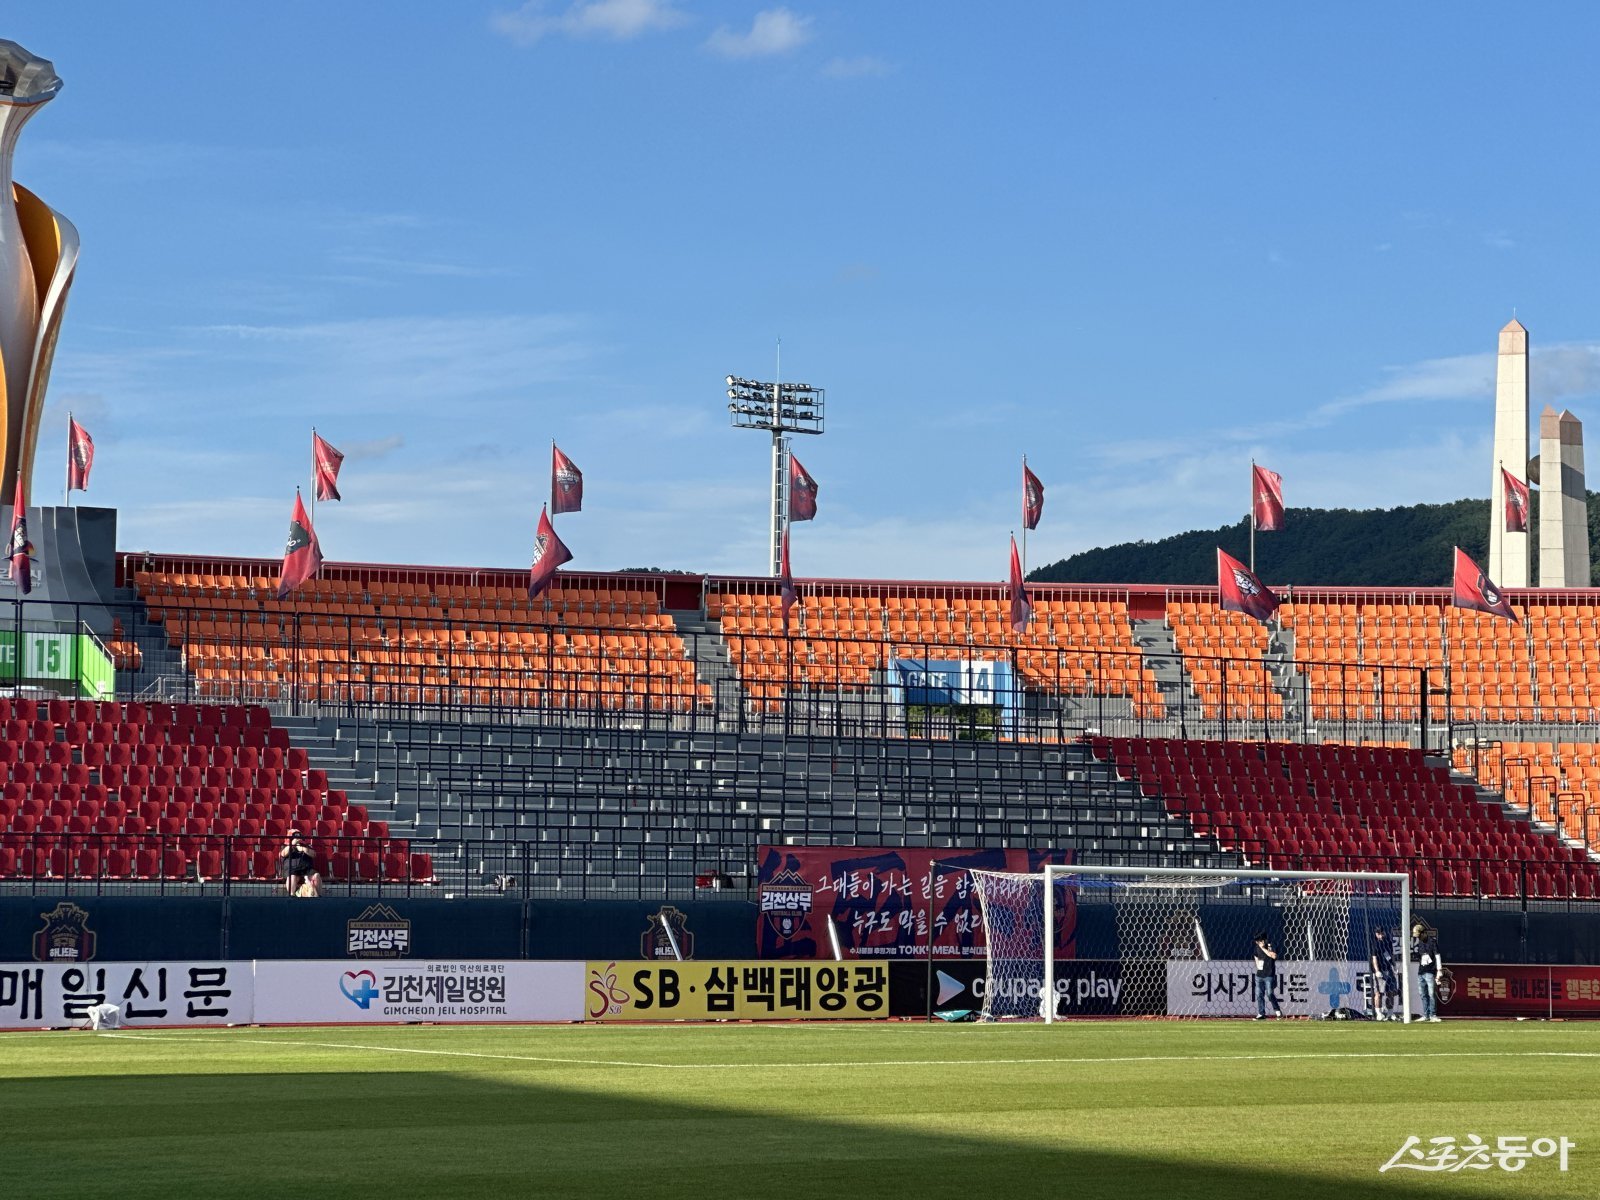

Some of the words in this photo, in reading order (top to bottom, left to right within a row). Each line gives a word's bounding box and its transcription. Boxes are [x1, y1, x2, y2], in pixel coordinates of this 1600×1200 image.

[35, 639, 60, 673] 15
[815, 872, 875, 900] 그대들이
[881, 872, 913, 896] 가는
[920, 871, 949, 900] 길을
[761, 891, 812, 912] 김천상무
[852, 911, 893, 934] 누구도
[898, 909, 929, 936] 막을
[934, 912, 949, 936] 수
[349, 929, 408, 952] 김천상무
[932, 945, 961, 955] MEAL
[427, 964, 457, 973] 의료법인
[0, 967, 232, 1020] 매일신문
[382, 974, 506, 1004] 김천제일병원
[1077, 970, 1122, 1006] play
[1467, 976, 1507, 999] 축구로
[1510, 977, 1562, 1000] 하나되는
[383, 1006, 435, 1015] GIMCHEON
[437, 1006, 457, 1016] JEIL
[459, 1006, 508, 1015] HOSPITAL
